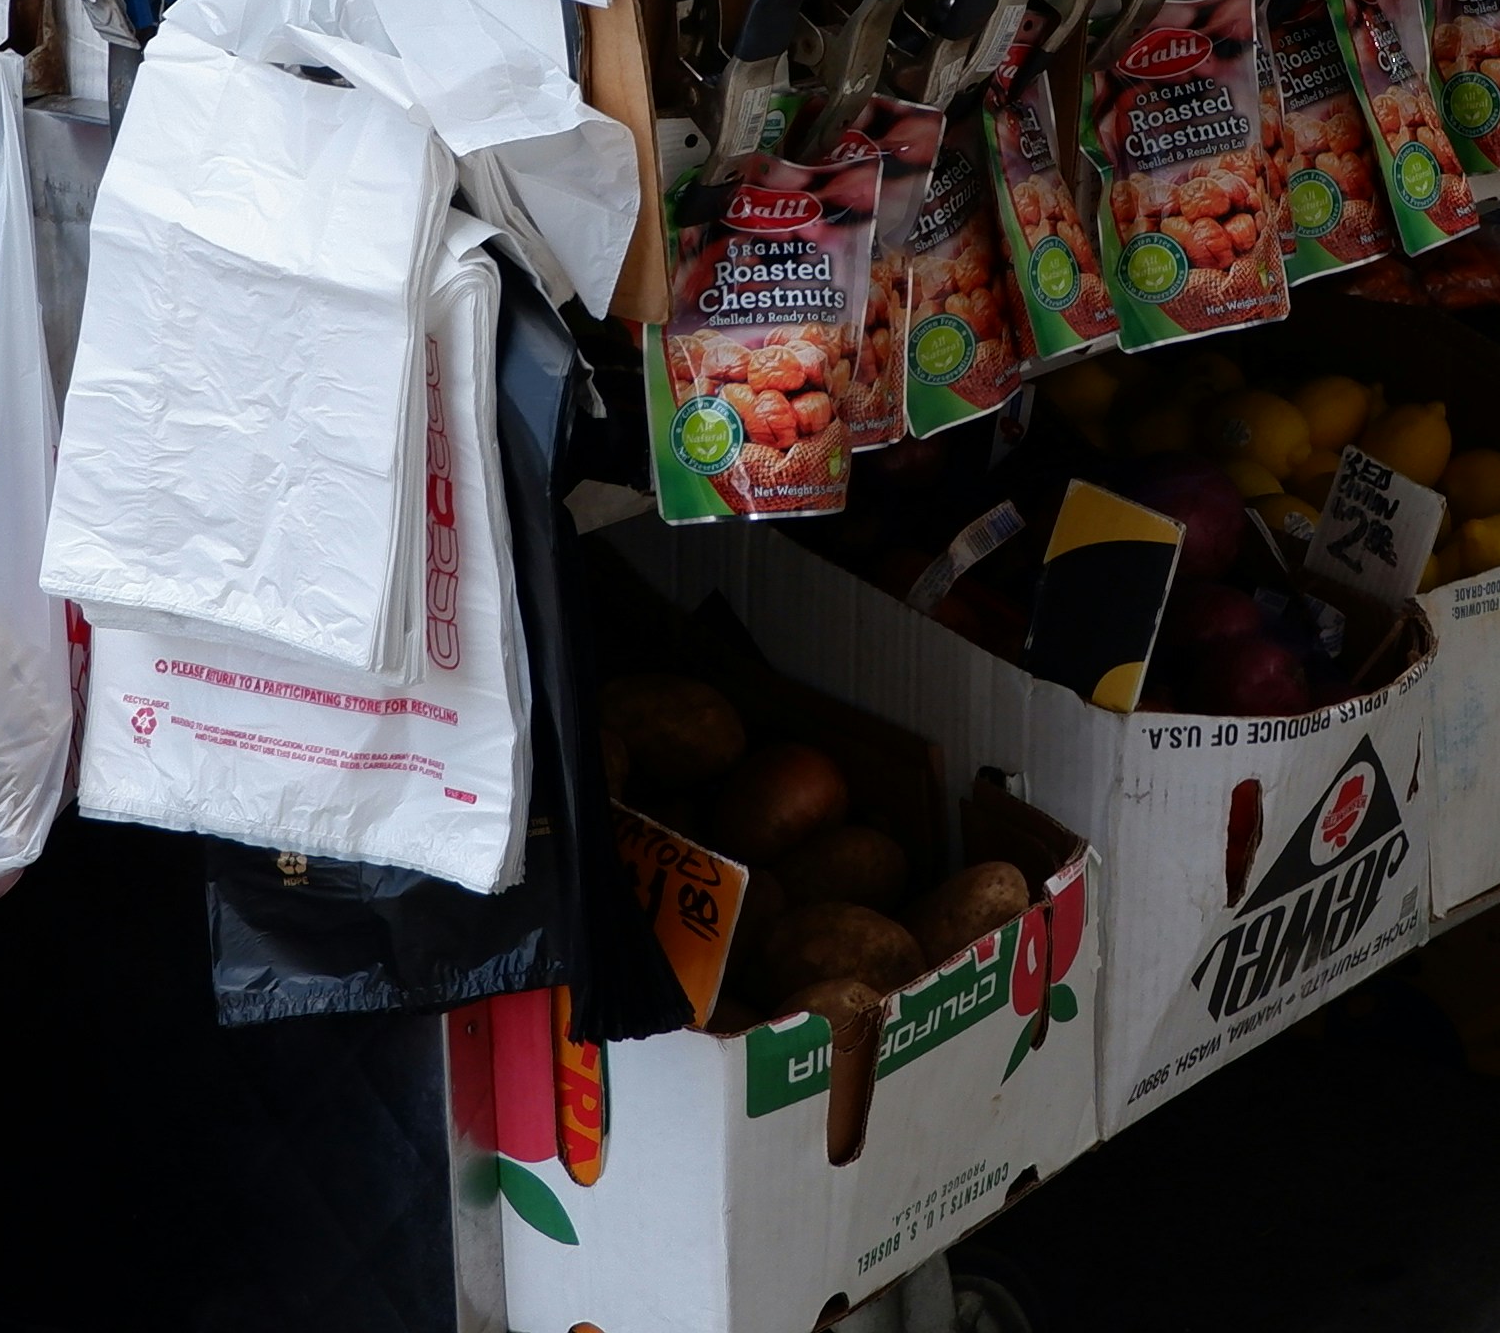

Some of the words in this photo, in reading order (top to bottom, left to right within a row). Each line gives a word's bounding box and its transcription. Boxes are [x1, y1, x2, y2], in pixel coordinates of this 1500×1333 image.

[1125, 36, 1199, 71] Galil
[1136, 77, 1217, 108] ORGANIC
[1128, 86, 1234, 134] Roasted
[1124, 114, 1249, 159] Chestnuts
[1136, 151, 1176, 172] Shelled
[1186, 143, 1218, 163] Ready
[726, 193, 810, 221] Galil
[727, 237, 818, 259] ORGANIC
[715, 254, 832, 287] Roasted
[699, 287, 846, 315] Chestnuts
[709, 313, 754, 327] Shelled
[755, 312, 765, 325] &
[768, 311, 805, 326] Ready
[806, 312, 820, 323] to
[820, 310, 837, 324] Eat
[753, 485, 774, 499] Net
[775, 484, 814, 500] Weight
[170, 660, 205, 680] PLEASE
[239, 675, 253, 690] TO
[253, 678, 262, 693] A
[262, 680, 342, 708] PARTICIPATING
[343, 695, 382, 713] STORE
[384, 699, 408, 714] FOR
[410, 700, 459, 725] RECYCLING
[1209, 724, 1241, 748] OF
[1247, 709, 1330, 745] PRODUCE
[942, 1158, 988, 1194] PRODUCE
[949, 1162, 1010, 1217] CONTENTS
[926, 1186, 939, 1208] OF
[857, 1231, 902, 1277] BUSHEL
